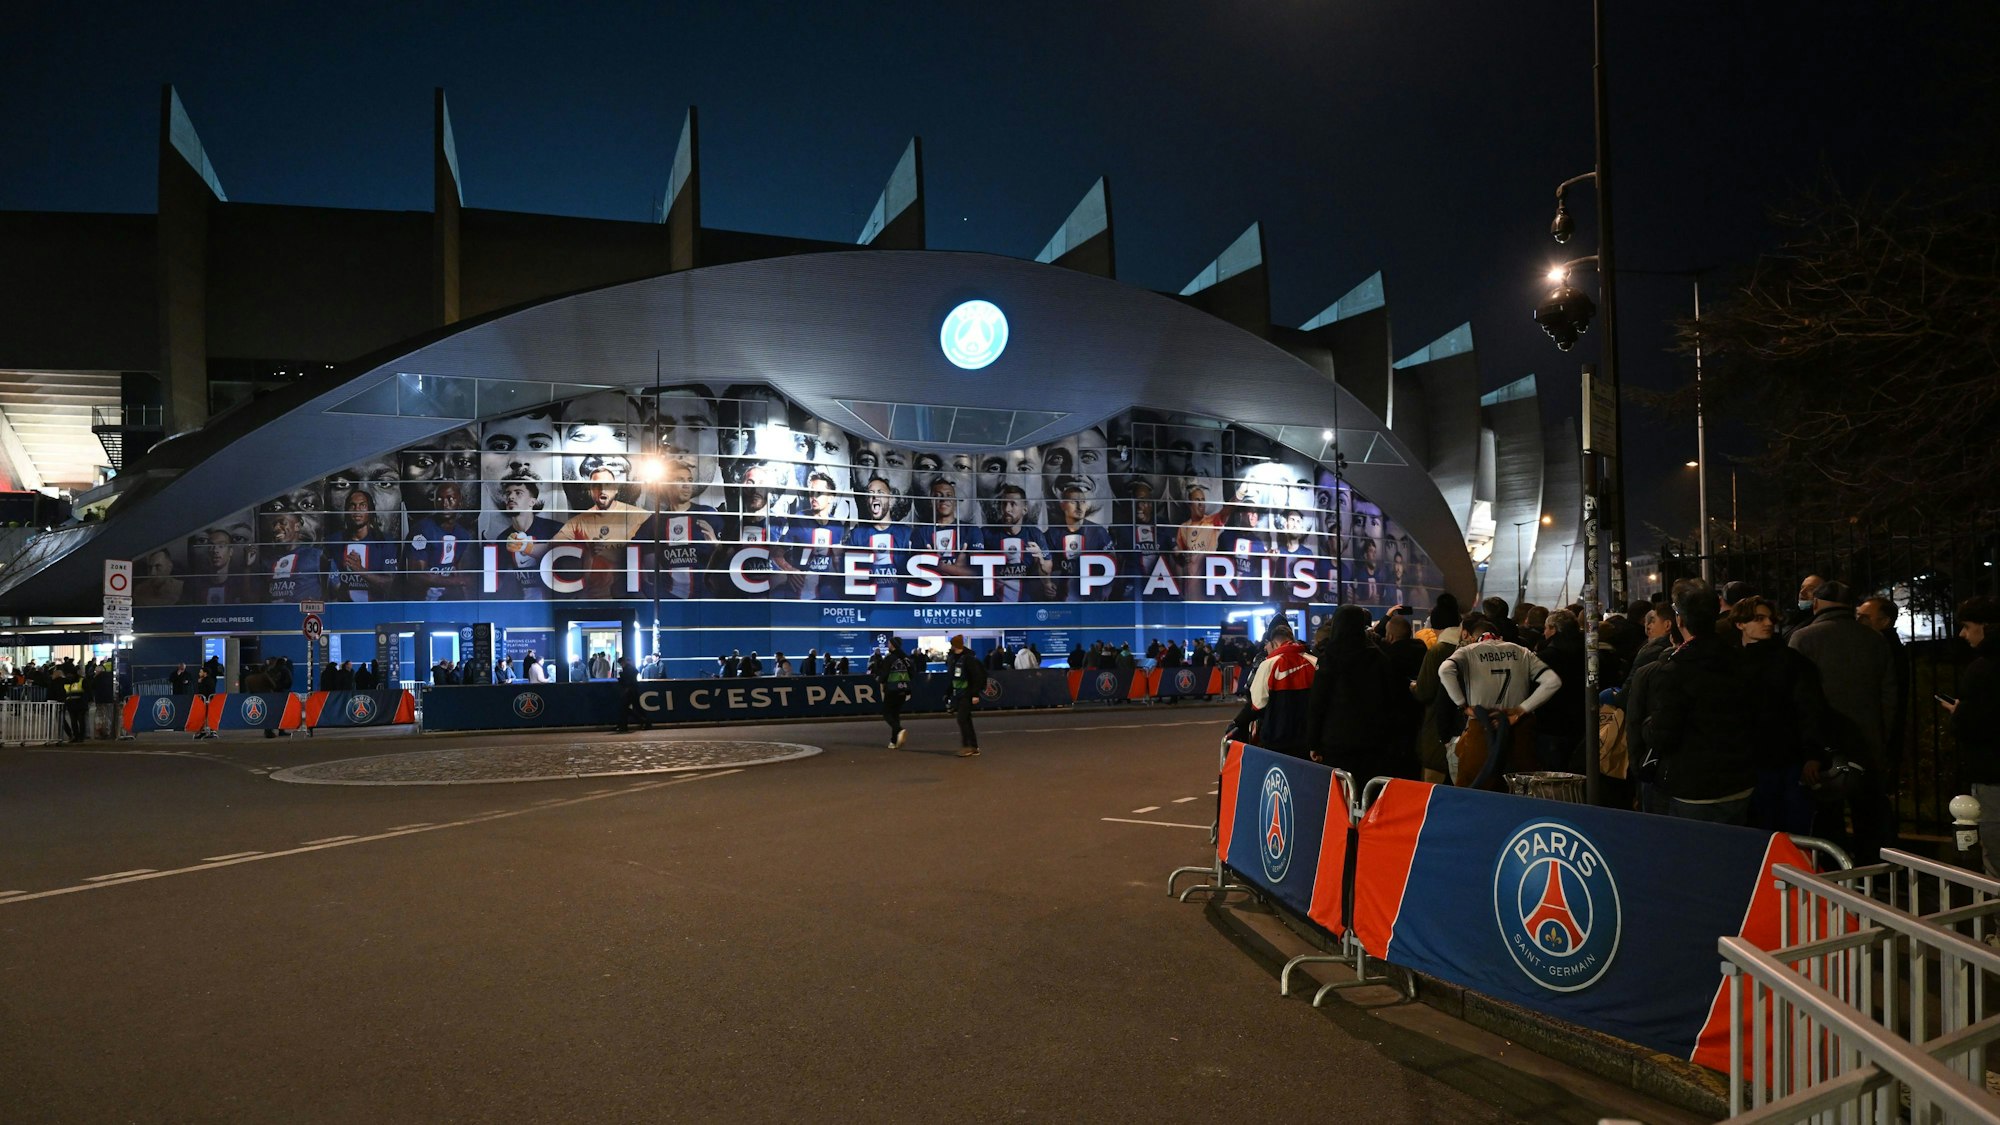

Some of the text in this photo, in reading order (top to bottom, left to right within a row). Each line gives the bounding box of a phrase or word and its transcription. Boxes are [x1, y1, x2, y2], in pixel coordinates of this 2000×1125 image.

[663, 548, 697, 560] QATAR
[670, 556, 698, 564] AIRWAYS
[483, 545, 1319, 599] ICI C'EST PARIS
[823, 608, 856, 616] PORTE
[857, 610, 867, 622] L
[914, 609, 982, 617] BIENVENUE
[836, 616, 856, 624] GATE
[924, 617, 972, 625] WELCOME
[307, 621, 319, 634] 30
[1491, 669, 1511, 704] 7
[639, 684, 885, 711] CI C'EST PARI
[1265, 773, 1289, 804] PARIS
[1514, 831, 1598, 877] PARIS
